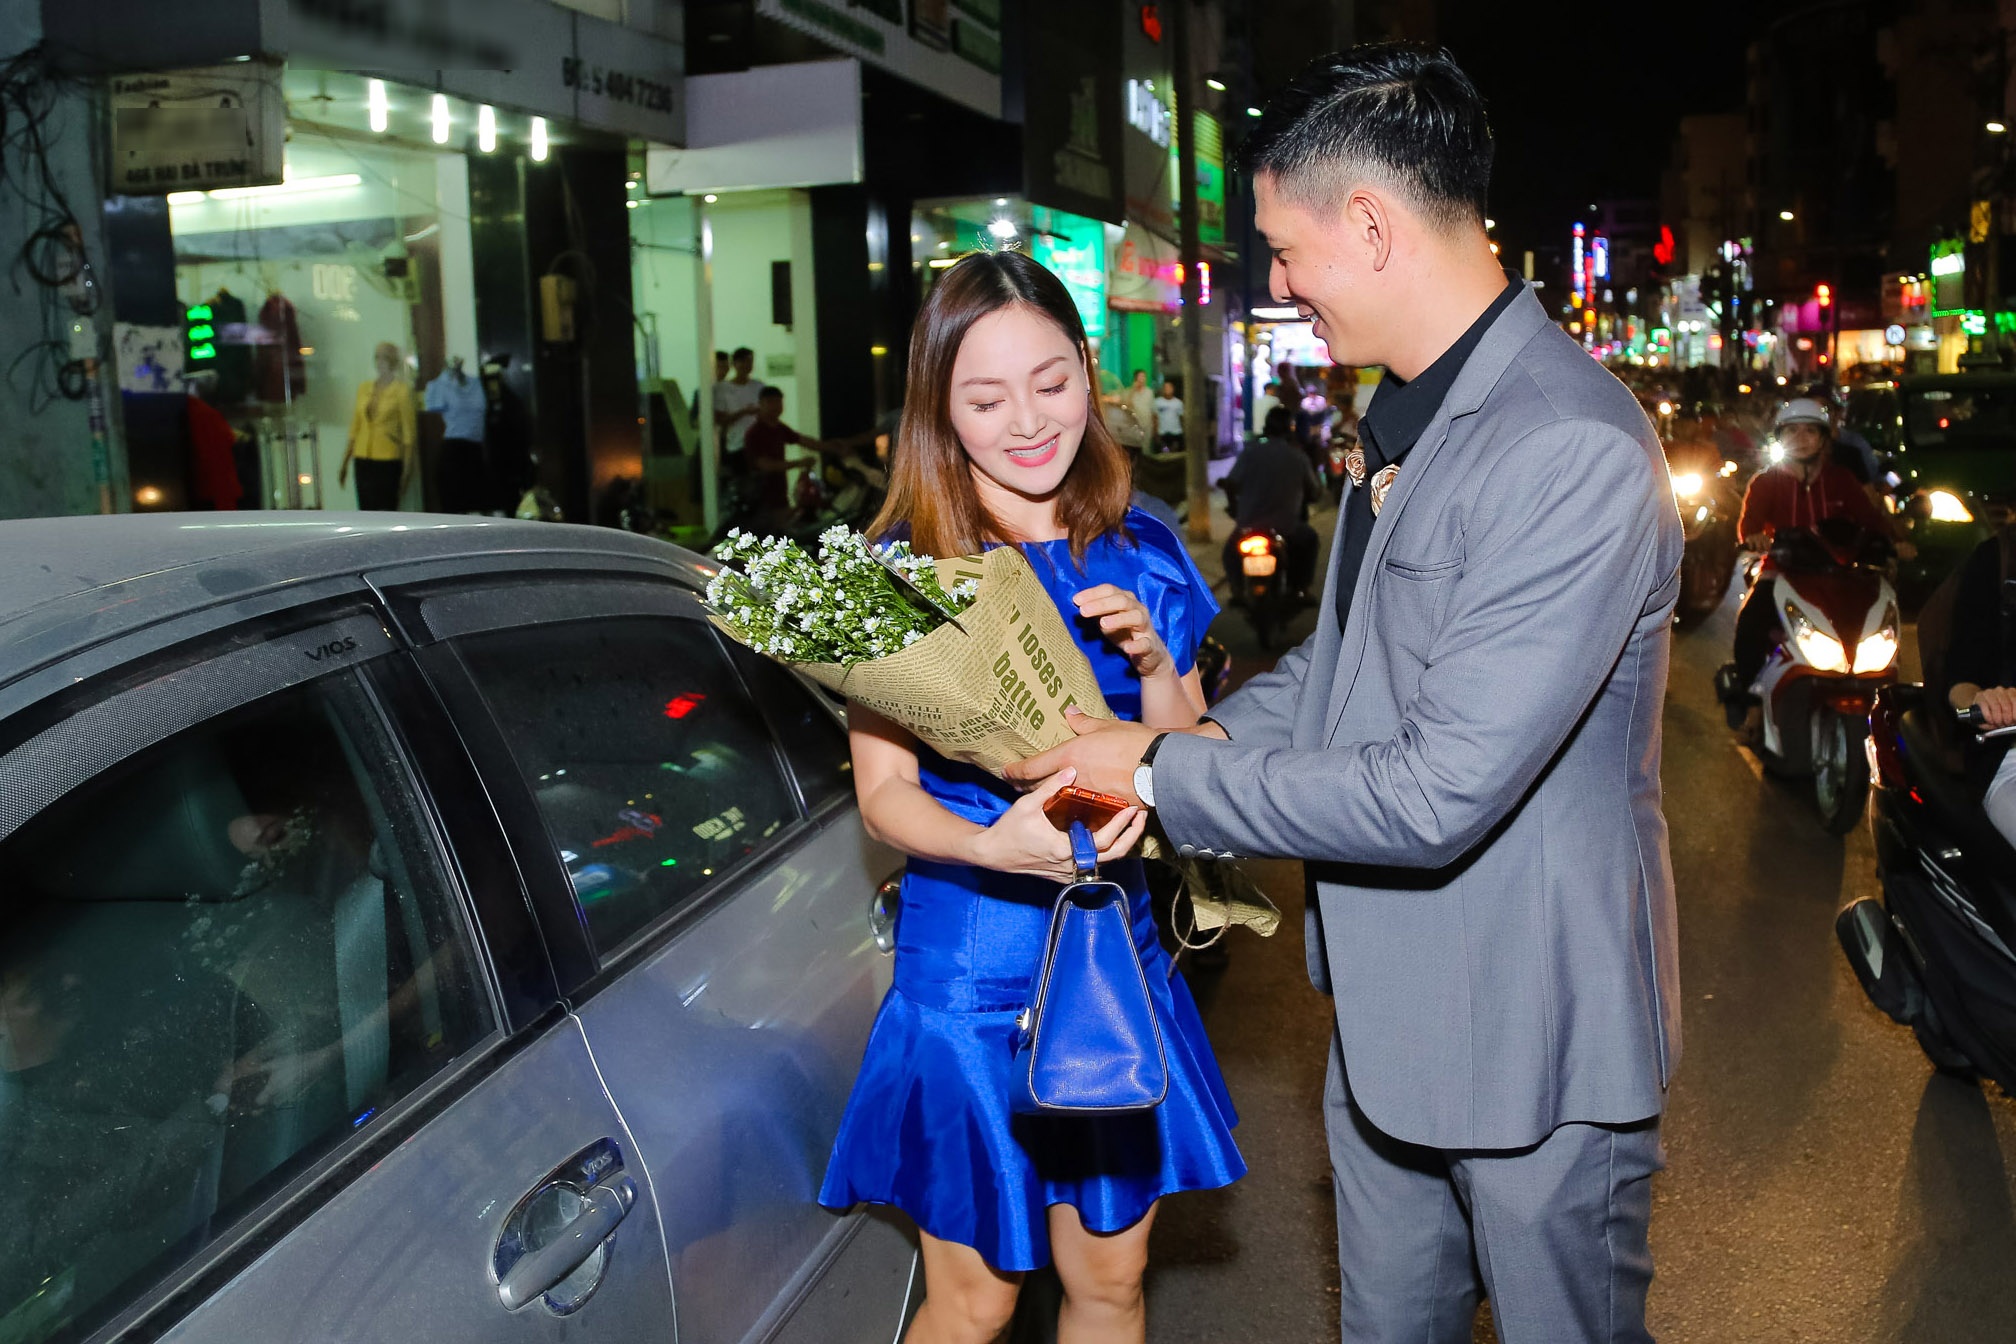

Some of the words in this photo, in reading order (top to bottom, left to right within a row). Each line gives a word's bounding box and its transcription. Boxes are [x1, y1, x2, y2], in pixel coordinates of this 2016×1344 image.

[304, 636, 357, 661] VIOS
[1017, 623, 1063, 698] loses
[993, 650, 1045, 731] battle
